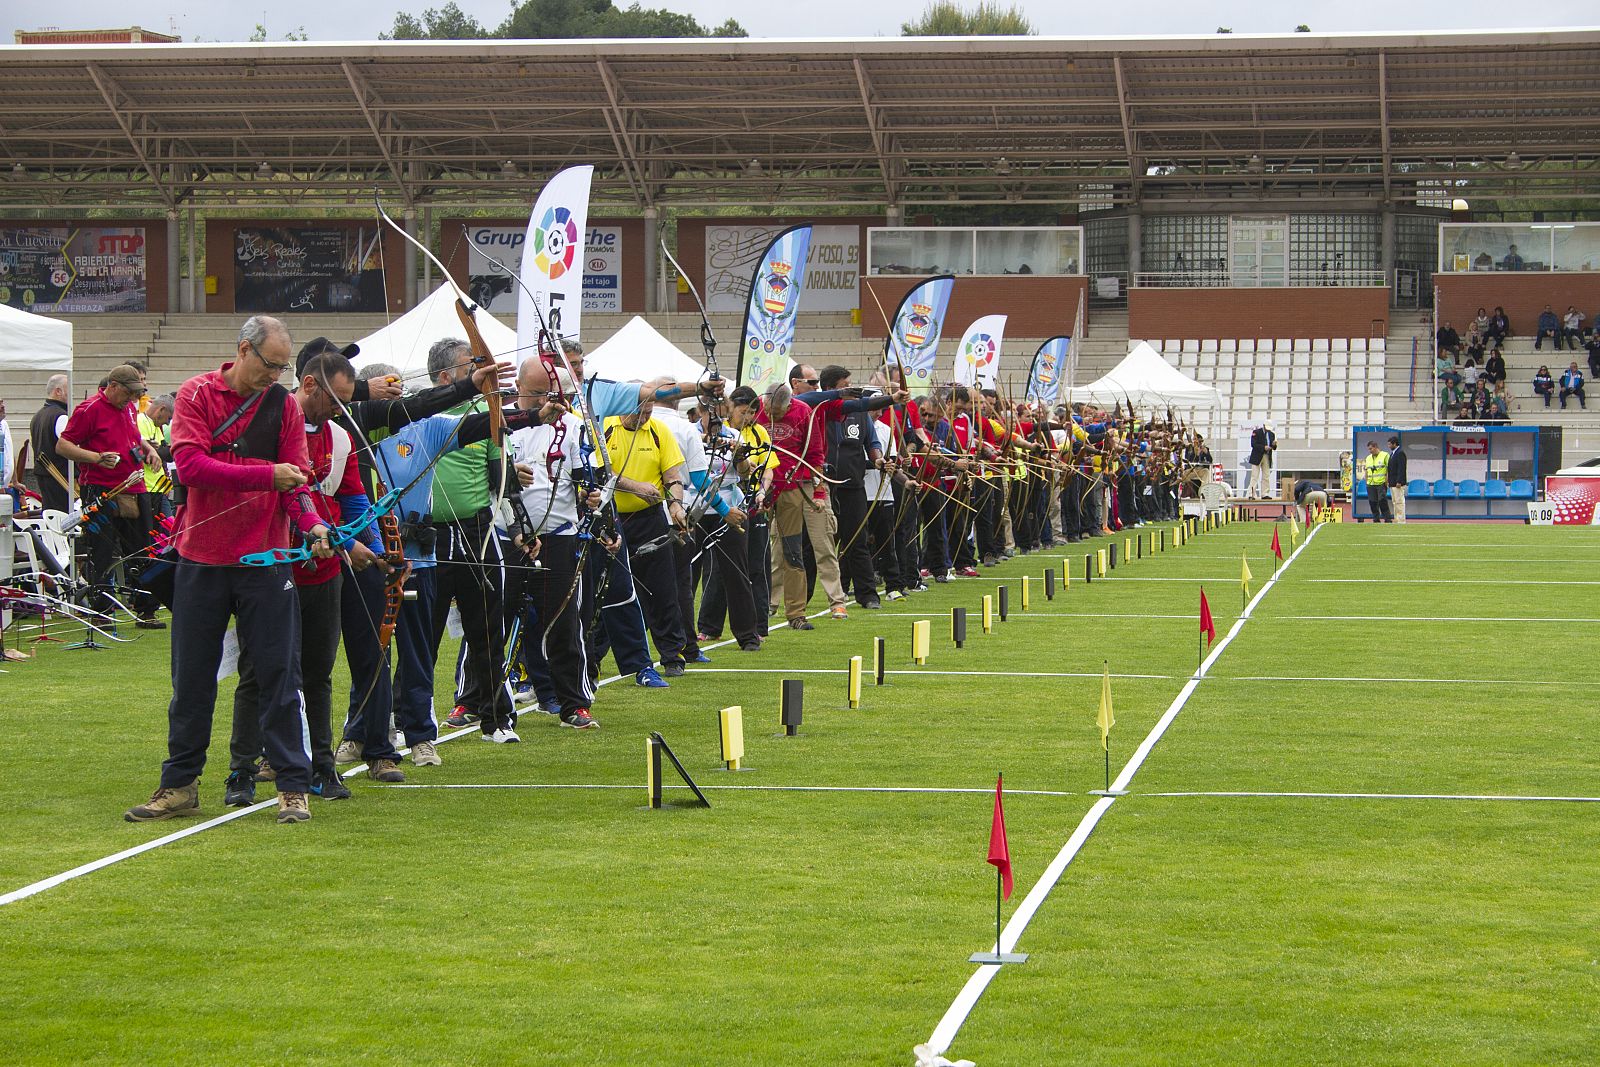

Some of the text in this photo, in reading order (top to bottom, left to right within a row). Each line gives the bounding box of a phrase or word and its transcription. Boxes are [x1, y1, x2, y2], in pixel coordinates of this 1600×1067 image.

[15, 229, 61, 248] Cuevita
[97, 235, 144, 254] STOP
[249, 237, 308, 262] Seis Reales
[818, 244, 845, 265] FOSO,
[847, 244, 860, 264] 93
[74, 255, 112, 266] ABIERTO
[592, 261, 604, 269] KIA
[87, 266, 97, 277] DE
[99, 266, 109, 276] LA
[54, 272, 67, 284] 5€
[583, 277, 610, 287] del tajo
[806, 270, 857, 290] ARANJUEZ
[33, 304, 63, 313] AMPLIA
[65, 304, 104, 313] TERRAZA
[584, 301, 616, 309] 25 75
[549, 292, 566, 341] La
[1540, 509, 1553, 521] 09
